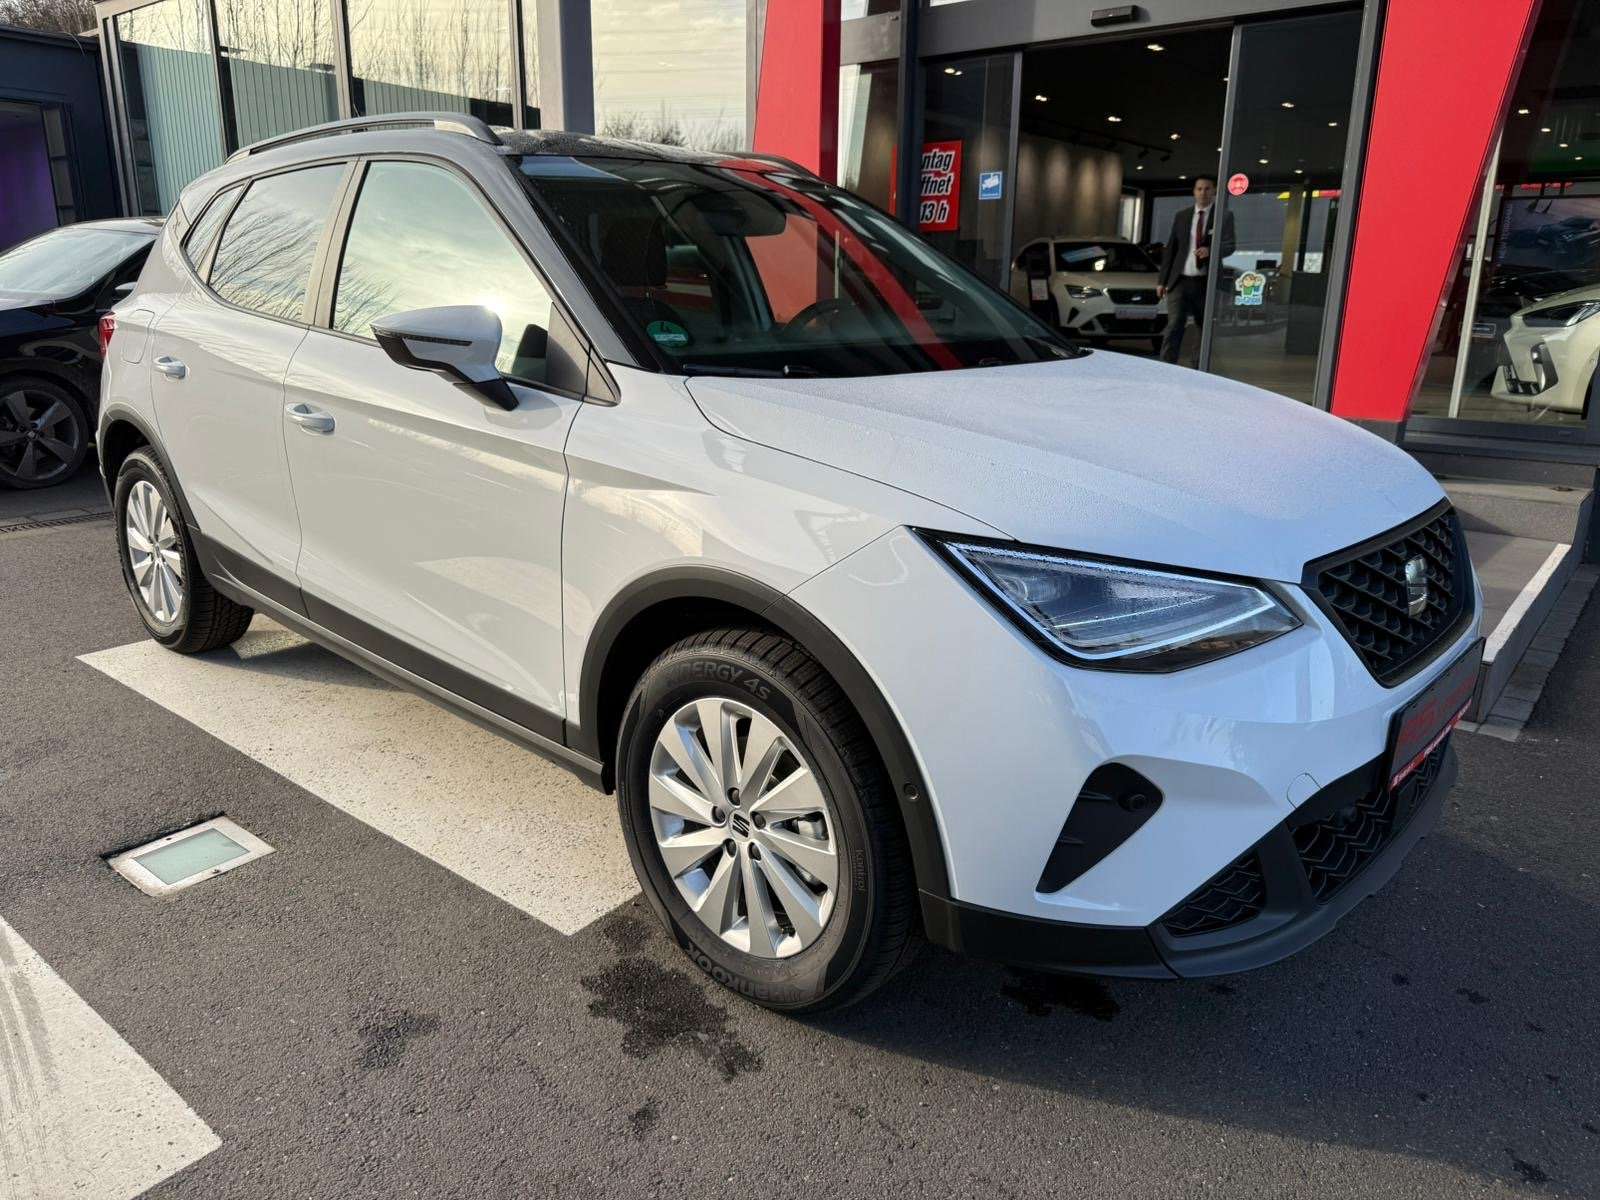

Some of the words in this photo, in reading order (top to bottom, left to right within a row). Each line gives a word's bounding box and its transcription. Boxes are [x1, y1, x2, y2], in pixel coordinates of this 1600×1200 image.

[920, 148, 956, 174] ntag
[920, 172, 955, 197] ffnet
[936, 200, 950, 223] h
[664, 660, 744, 682] NERGY
